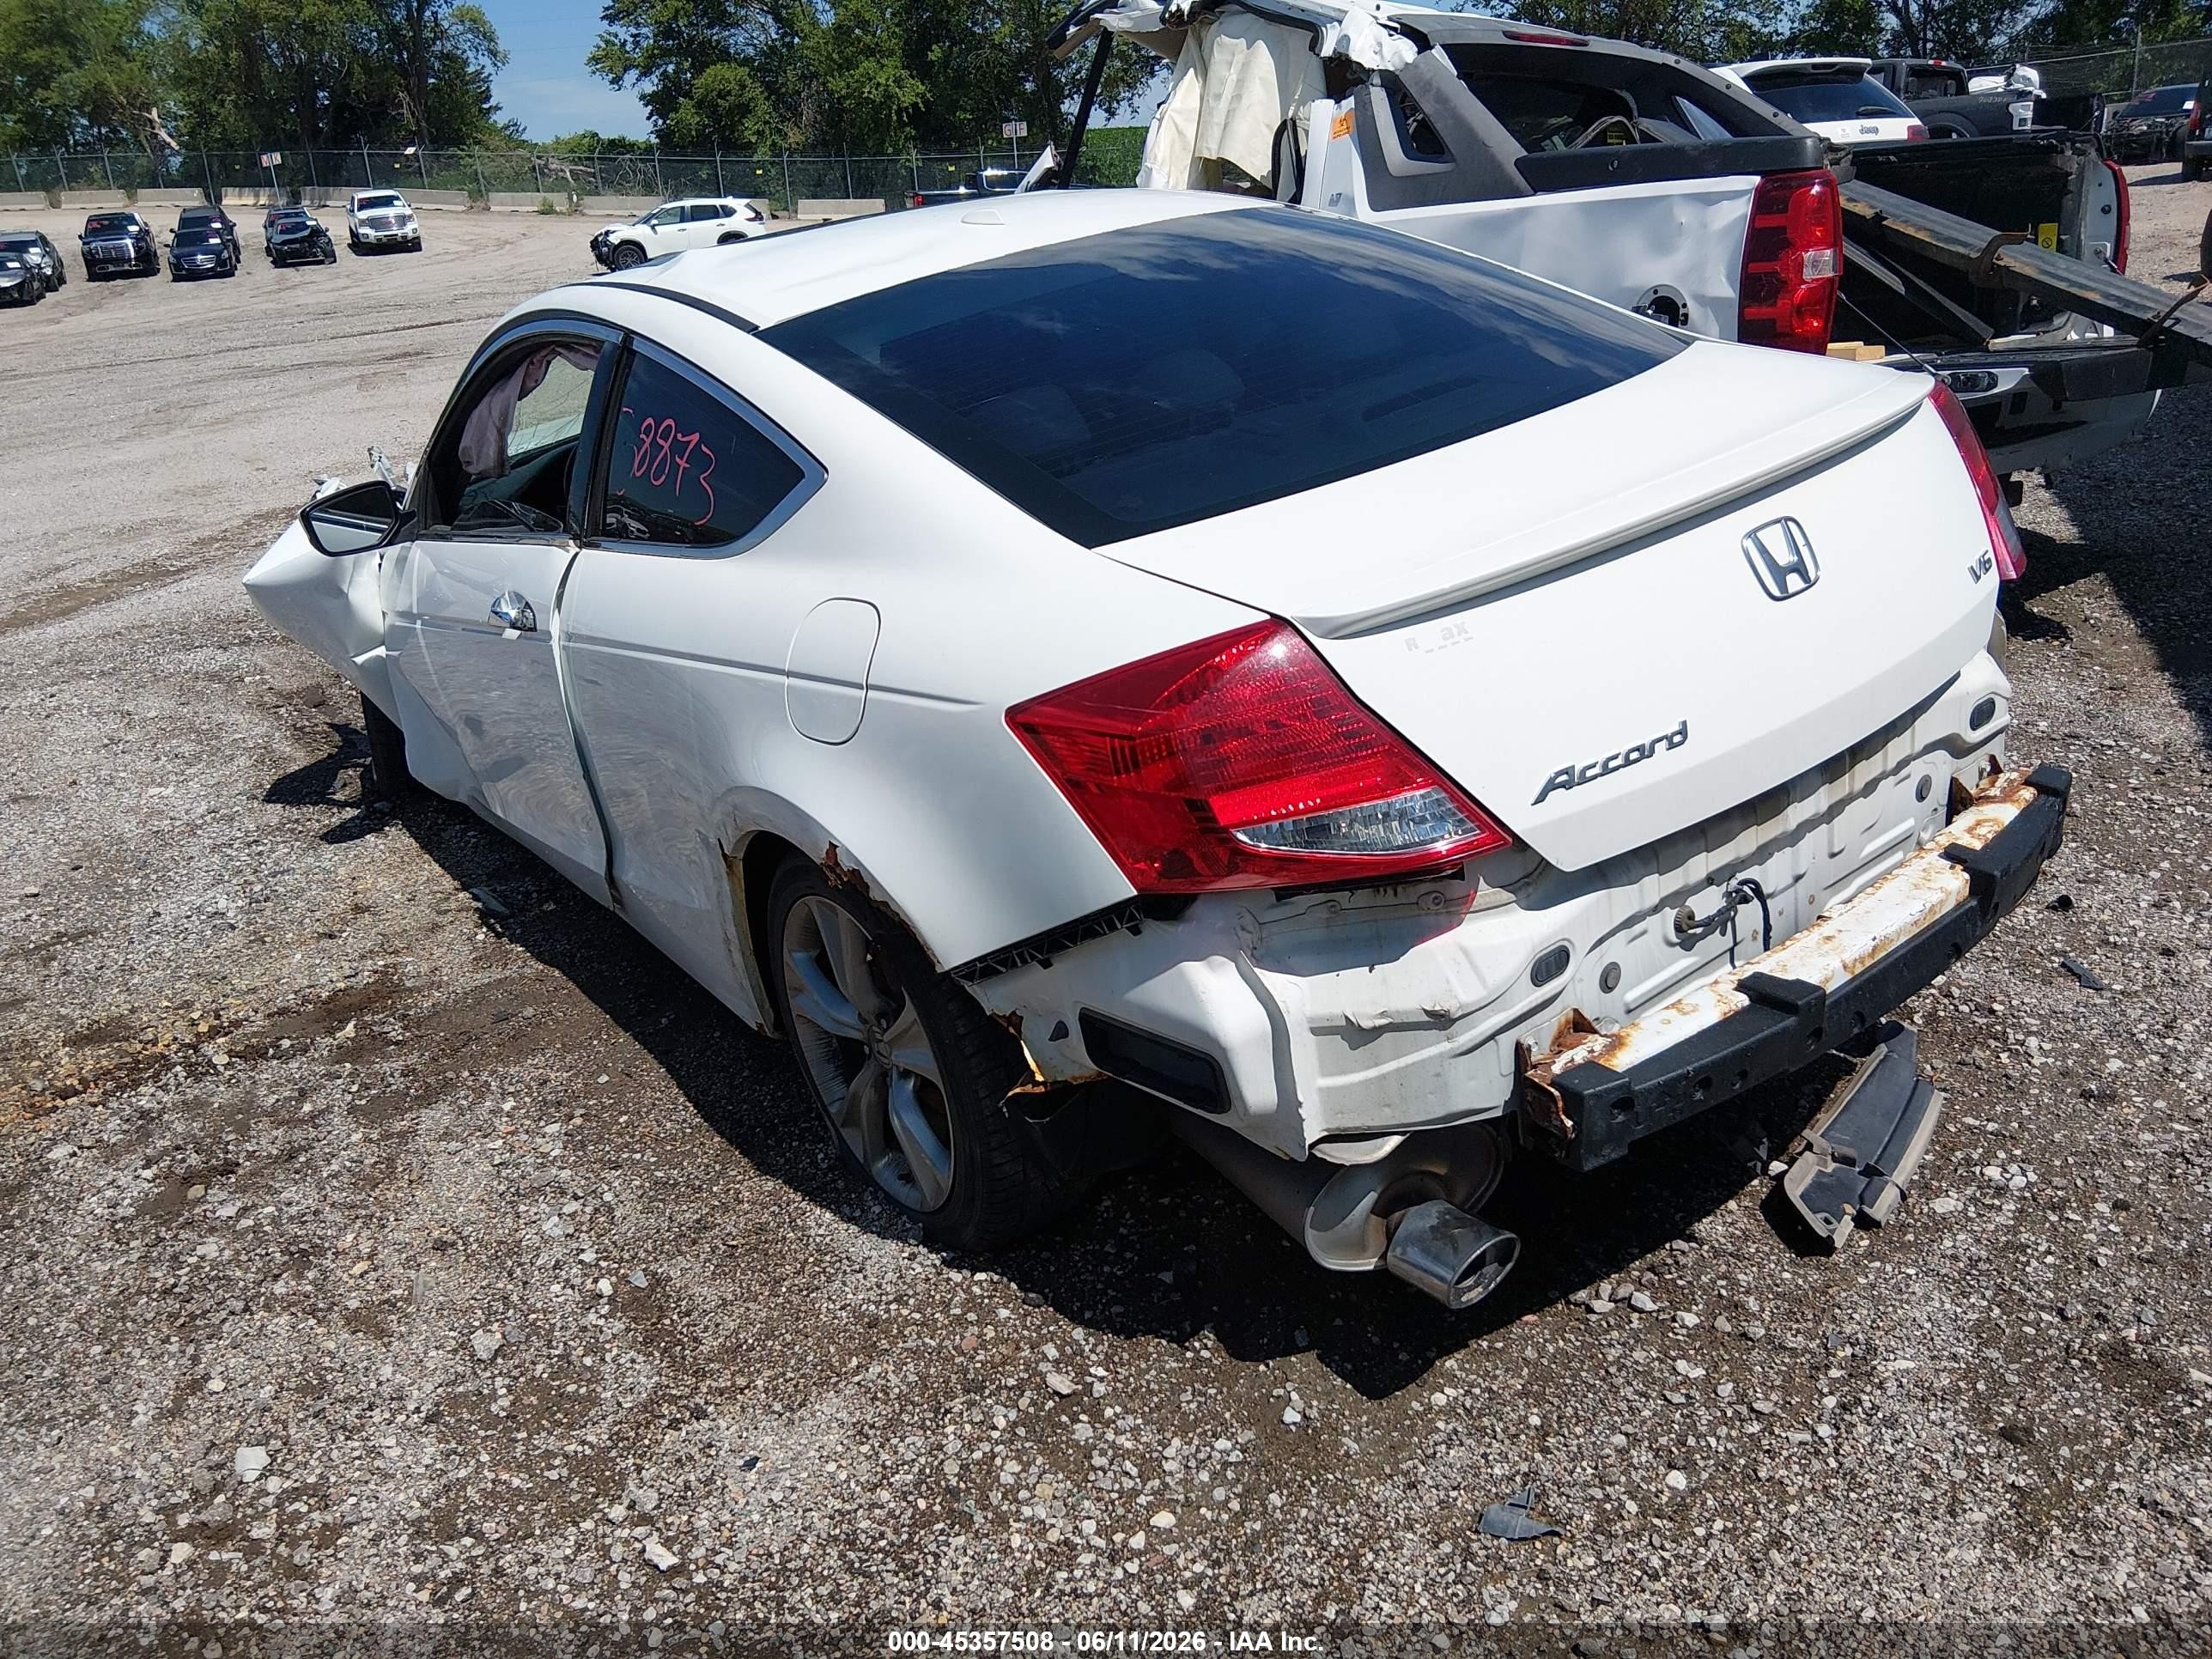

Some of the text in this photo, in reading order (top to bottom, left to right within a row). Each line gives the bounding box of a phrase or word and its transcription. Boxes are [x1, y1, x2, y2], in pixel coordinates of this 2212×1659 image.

[1004, 124, 1012, 137] G
[1858, 124, 1880, 136] Jeep
[1967, 549, 1993, 585] V6
[1530, 720, 1688, 806] Accord
